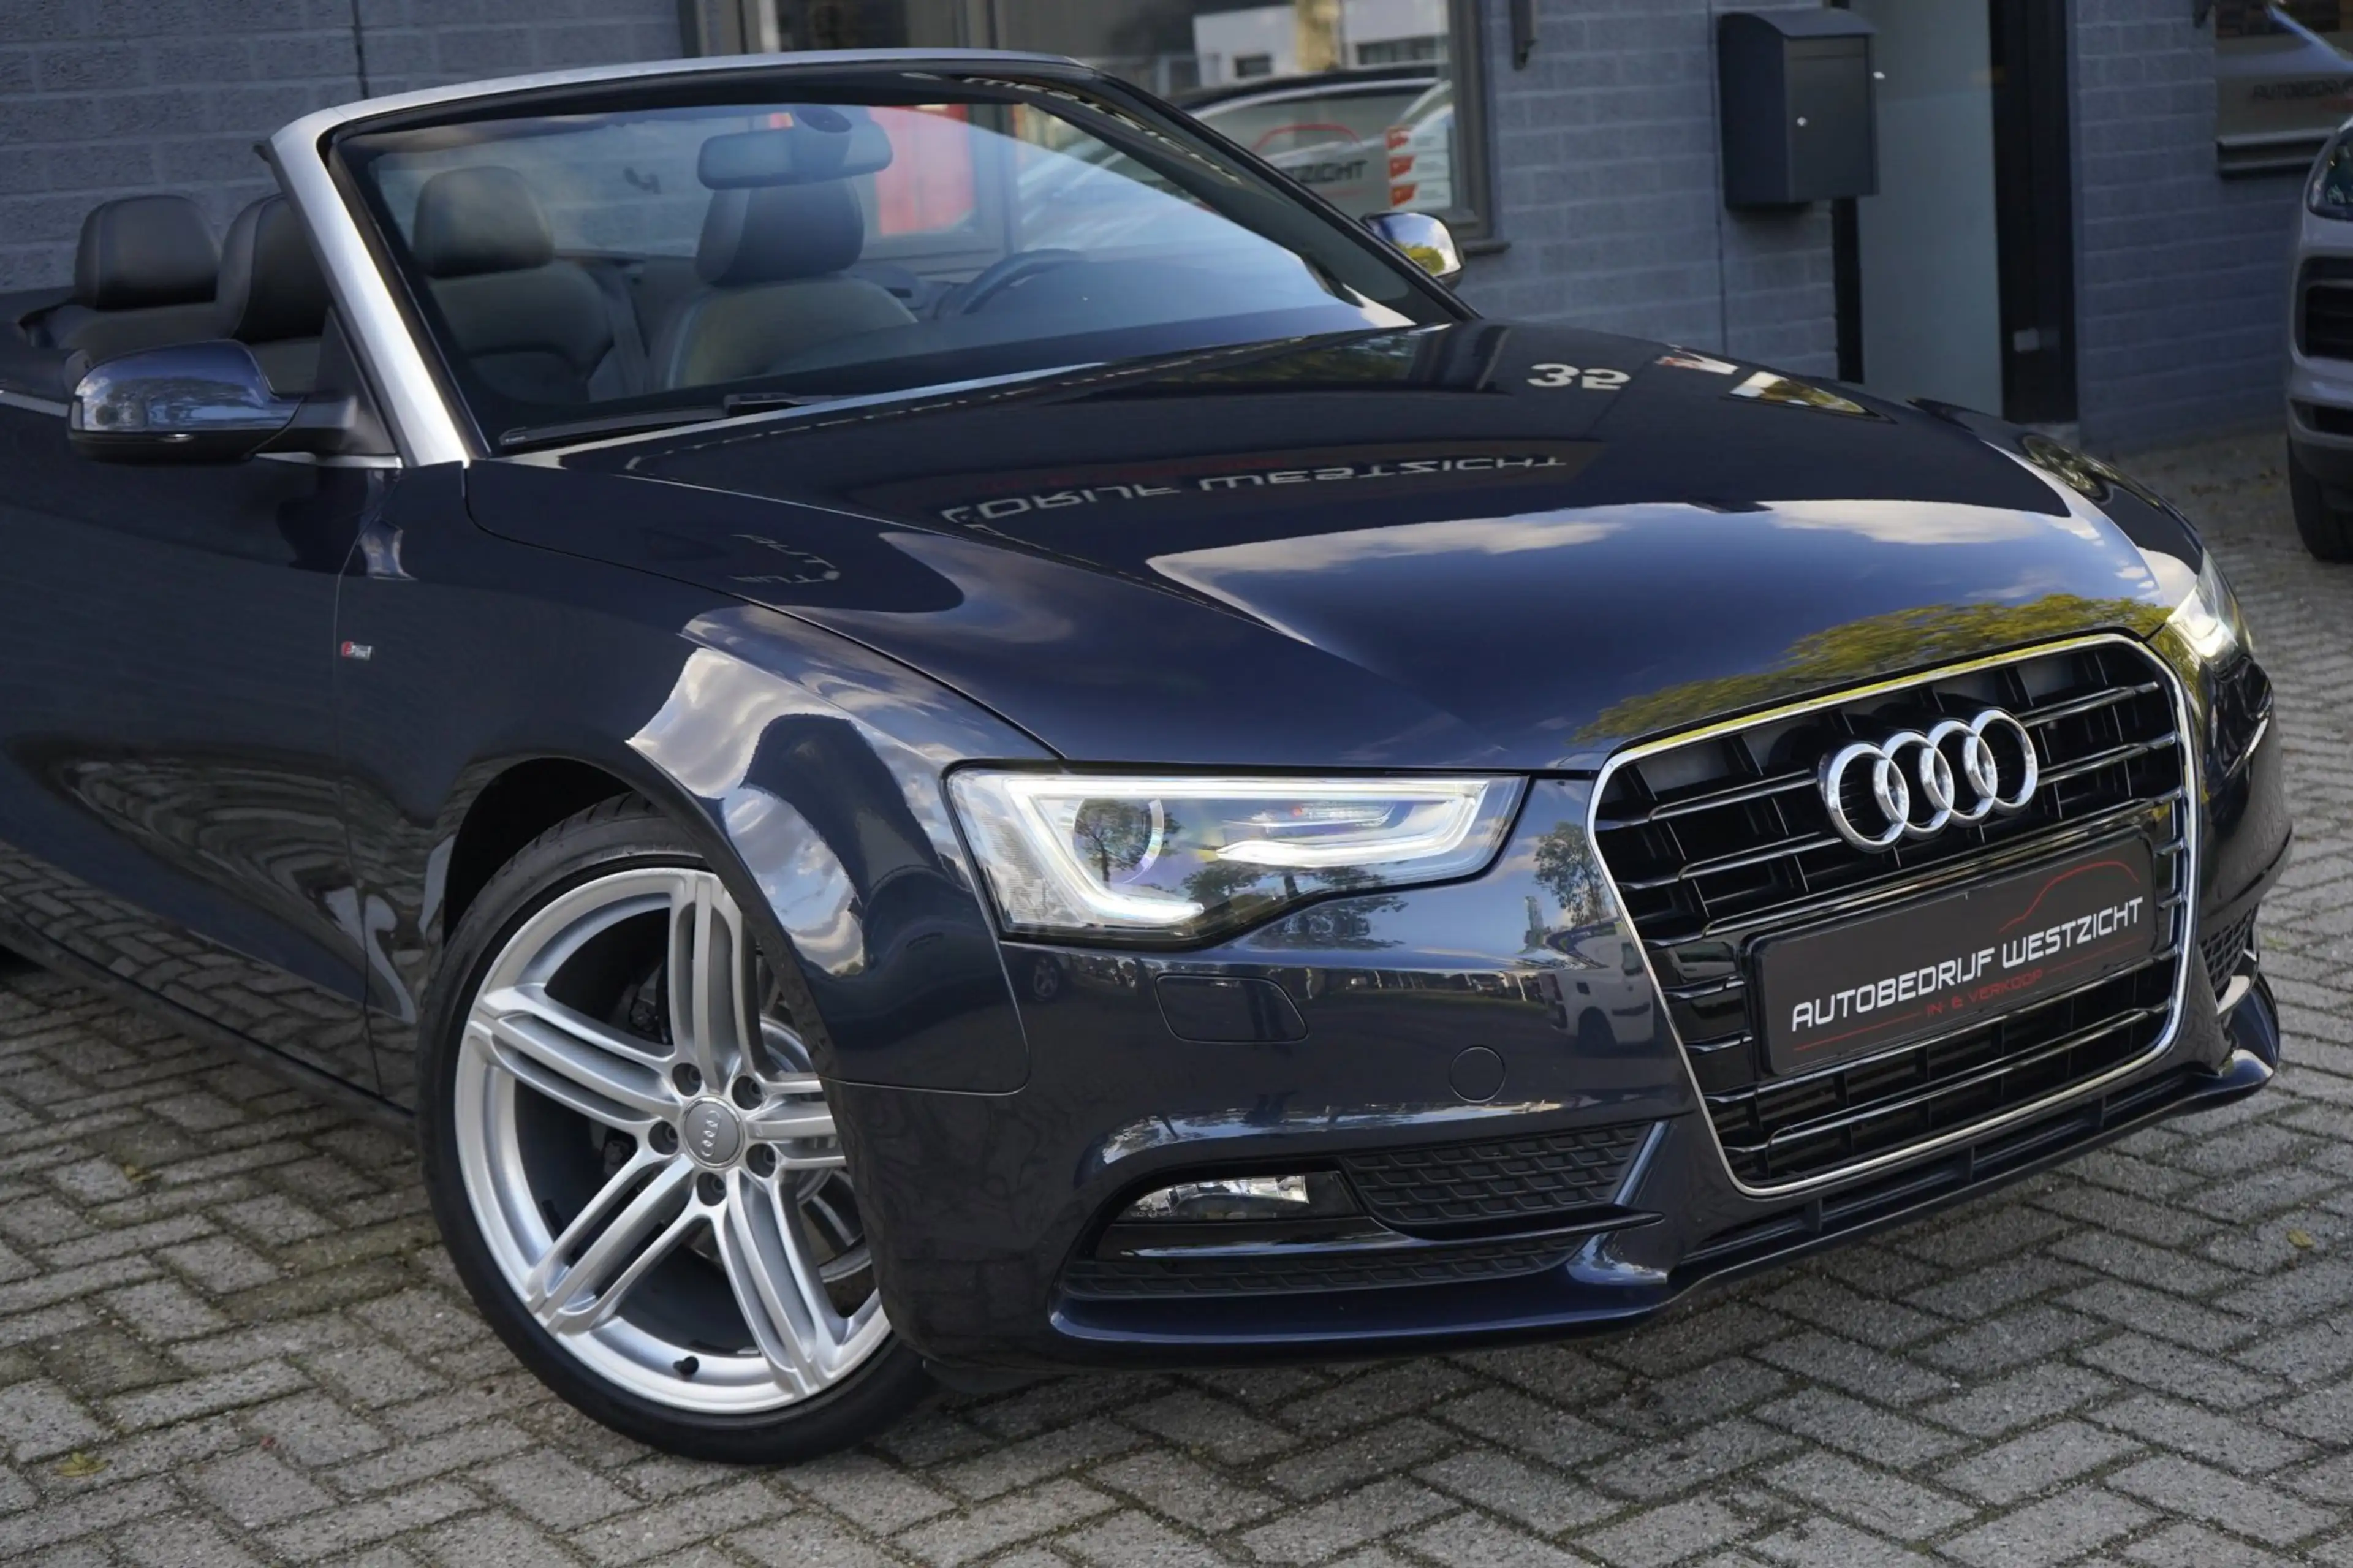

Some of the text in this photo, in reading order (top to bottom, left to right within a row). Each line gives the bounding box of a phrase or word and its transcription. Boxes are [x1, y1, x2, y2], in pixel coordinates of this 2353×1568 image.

[1792, 896, 2143, 1032] AUTOBEDRIJF WESTZICHT
[1967, 968, 2044, 1003] VERKOOP
